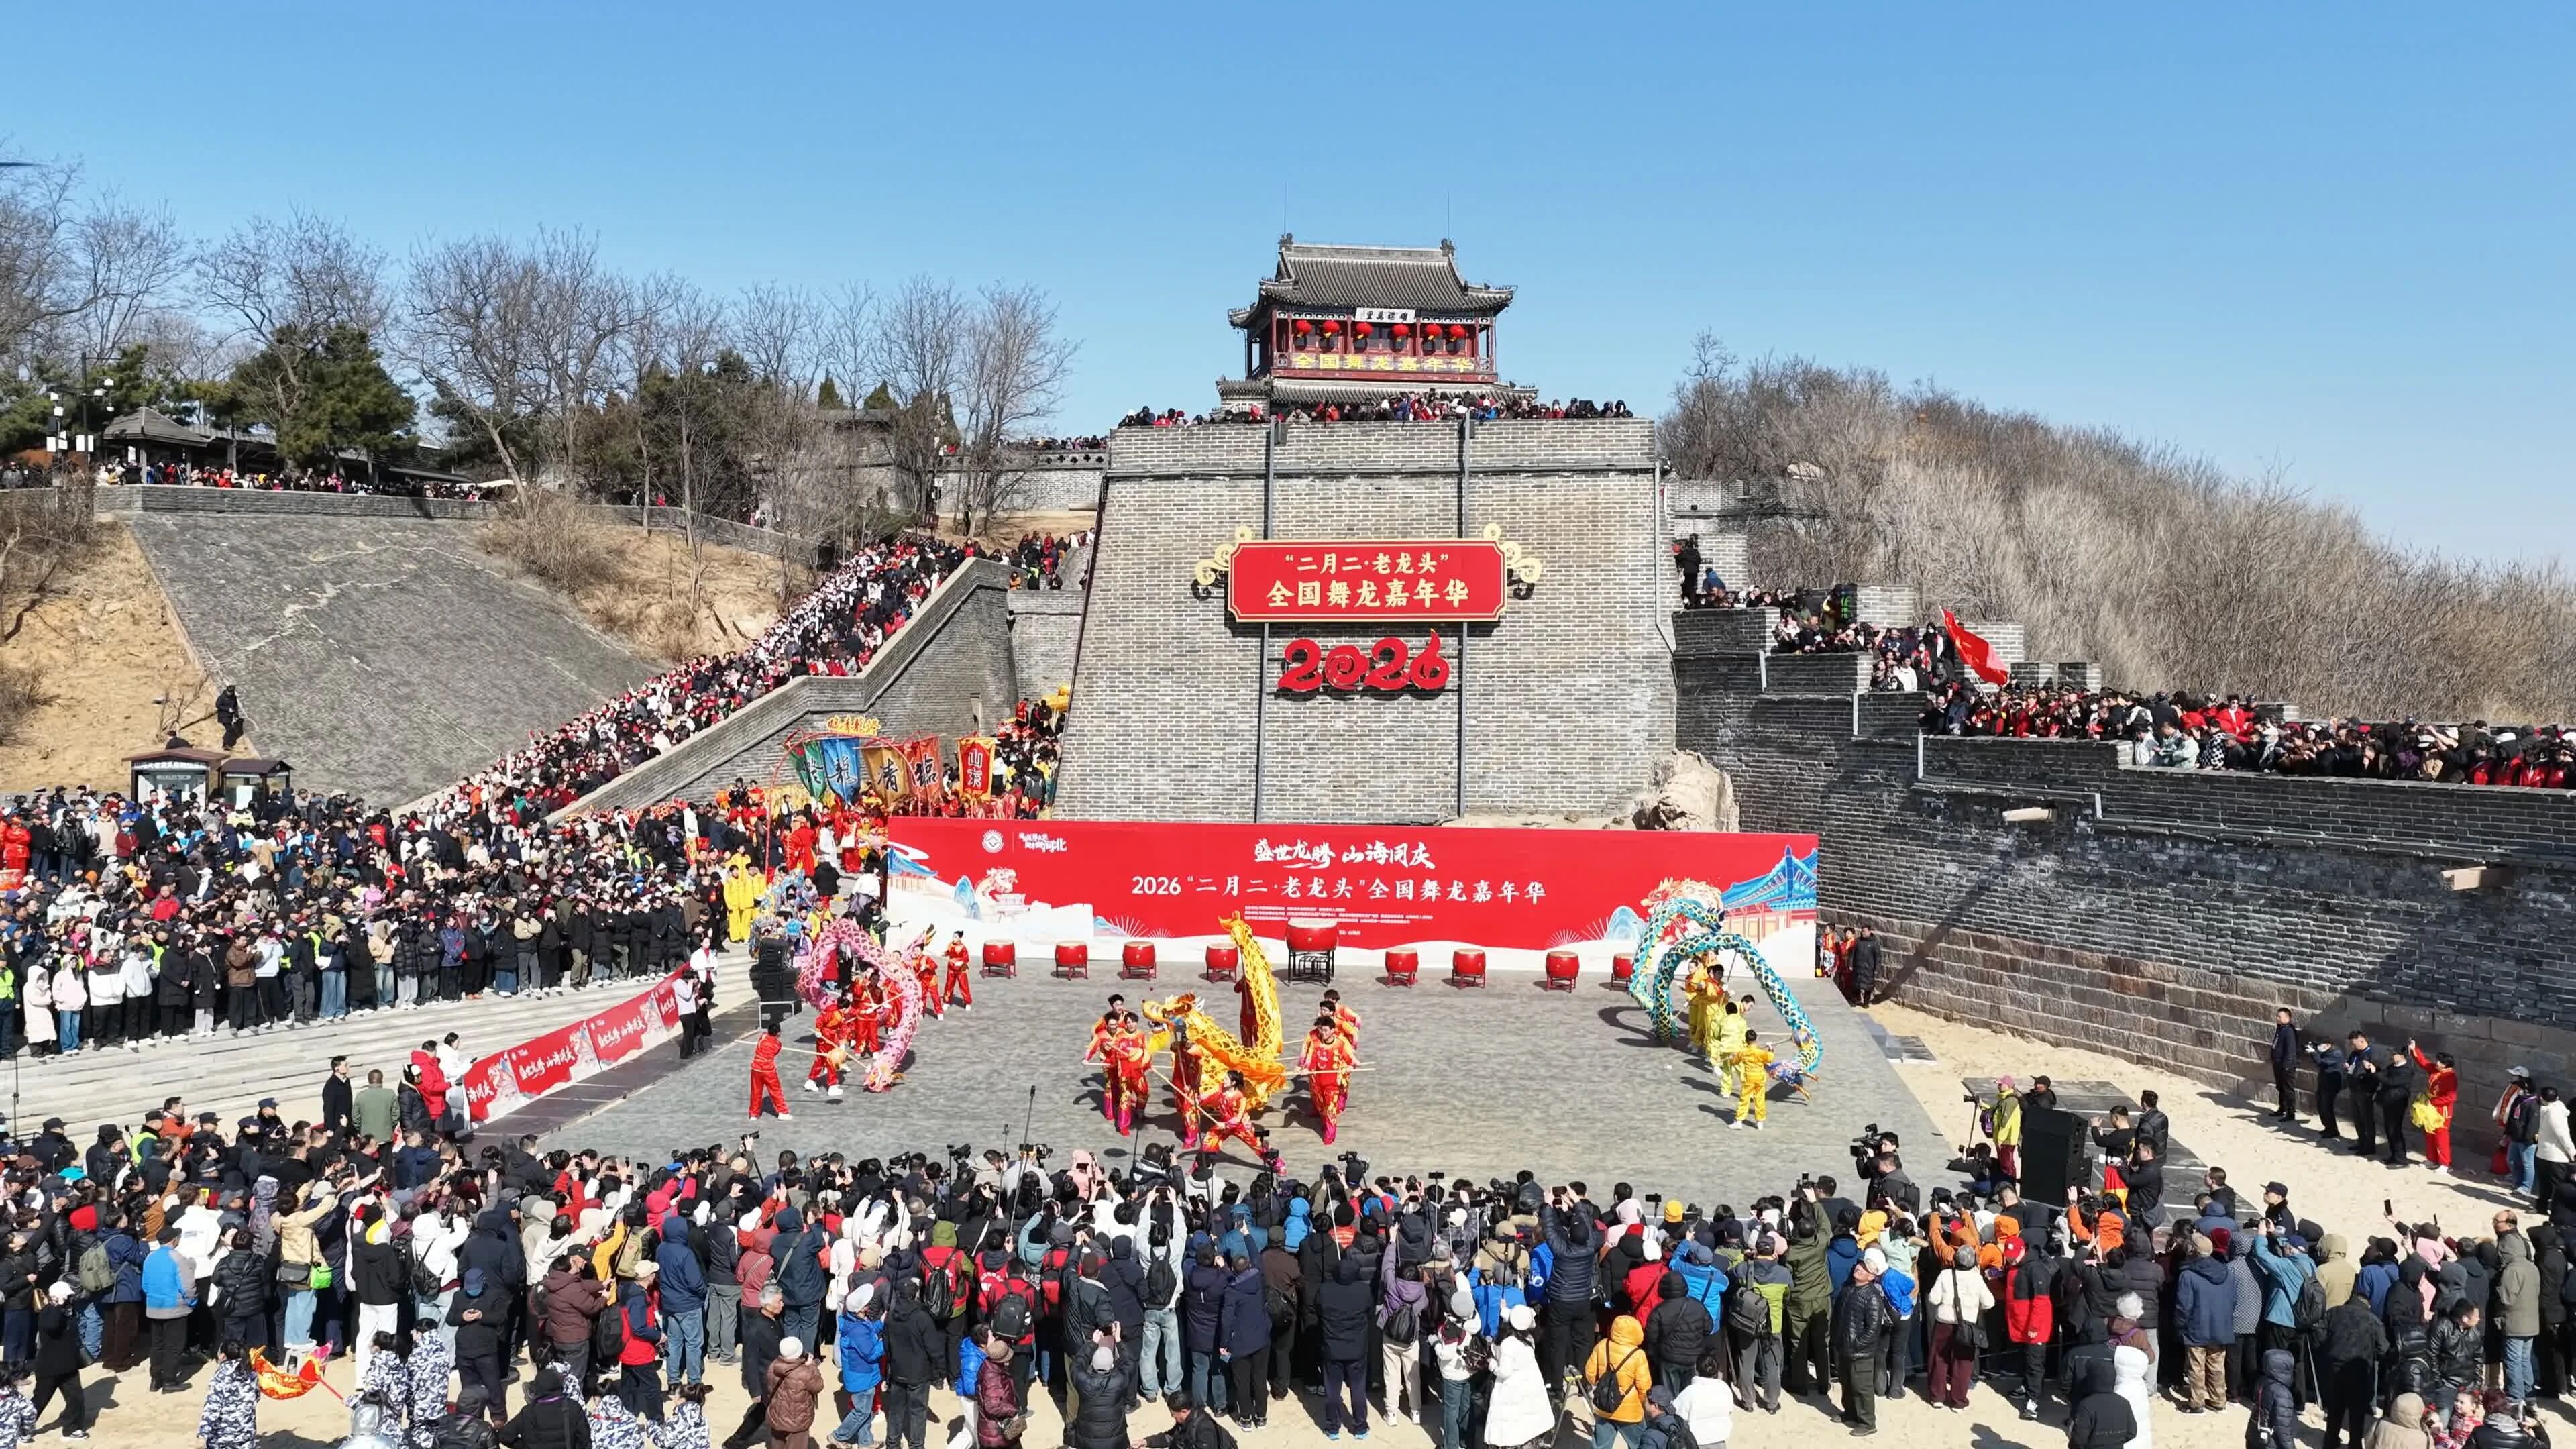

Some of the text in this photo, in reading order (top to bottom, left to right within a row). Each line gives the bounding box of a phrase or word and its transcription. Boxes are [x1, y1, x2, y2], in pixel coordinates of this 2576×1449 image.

[1292, 353, 1475, 373] 全国舞龙嘉年华
[1266, 579, 1470, 608] 全国舞龙嘉年华
[1277, 628, 1450, 691] 2026
[877, 759, 899, 793] 清
[1341, 840, 1436, 870] 山海同庆
